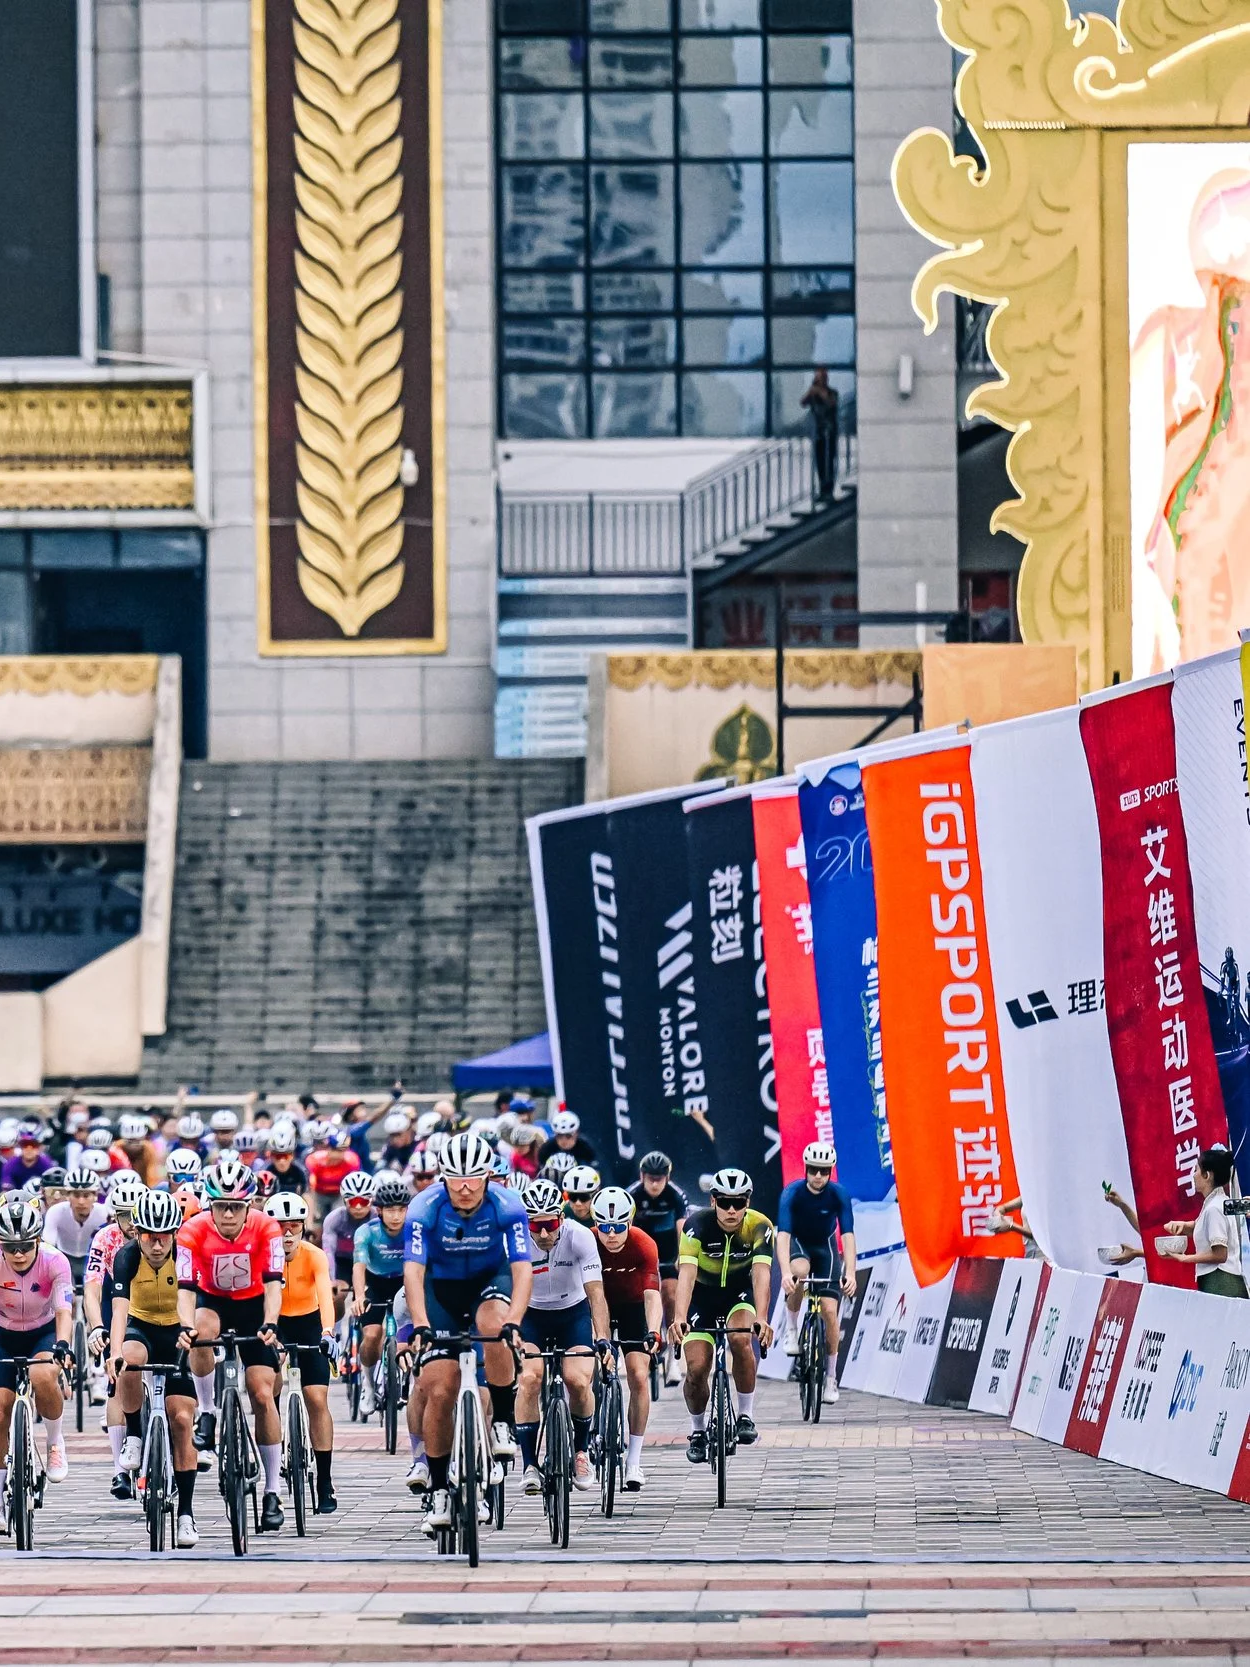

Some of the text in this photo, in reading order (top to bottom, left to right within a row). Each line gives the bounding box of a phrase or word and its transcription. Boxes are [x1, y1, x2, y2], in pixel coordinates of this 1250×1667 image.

[1144, 778, 1179, 802] SPORTS
[920, 783, 994, 1114] iGPSPORT
[1067, 979, 1105, 1015] 理
[659, 1007, 677, 1097] MONTON
[677, 976, 709, 1117] VALORE
[1141, 825, 1200, 1197] 艾维运动医学
